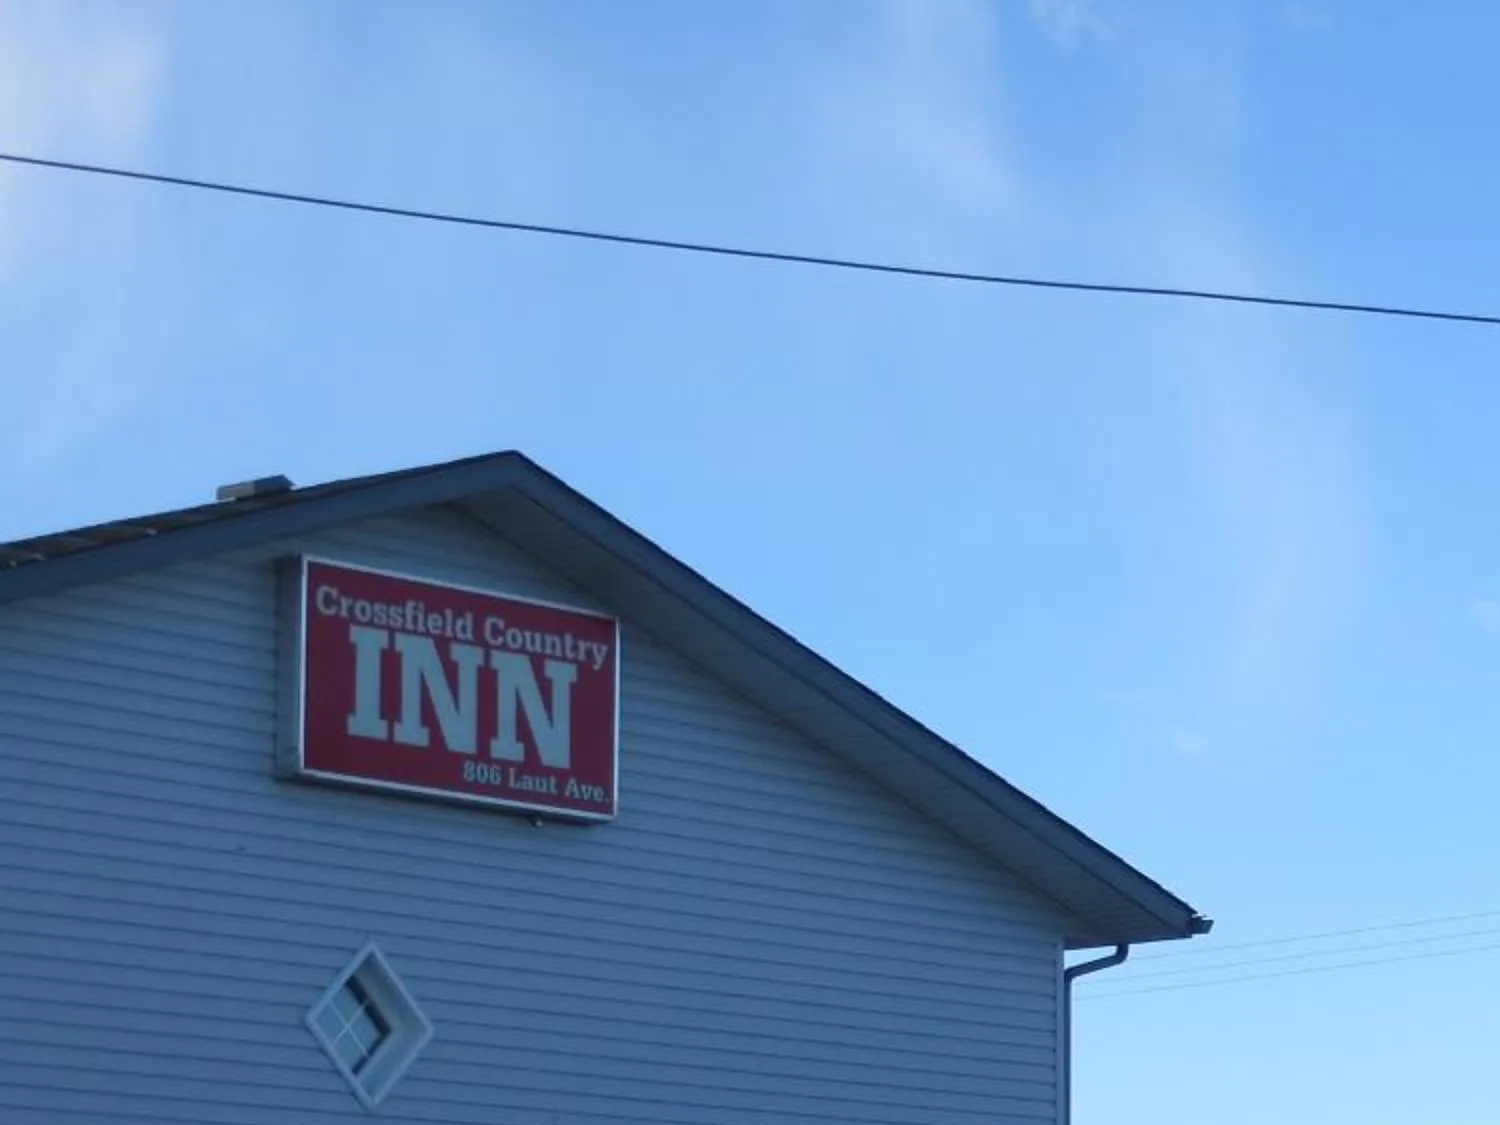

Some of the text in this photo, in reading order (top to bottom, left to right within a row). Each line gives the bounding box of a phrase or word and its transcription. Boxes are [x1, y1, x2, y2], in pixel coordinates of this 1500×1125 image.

[316, 585, 608, 670] Crossfield Country
[347, 625, 577, 769] INN
[462, 759, 502, 785] 806
[508, 766, 559, 794] Laut
